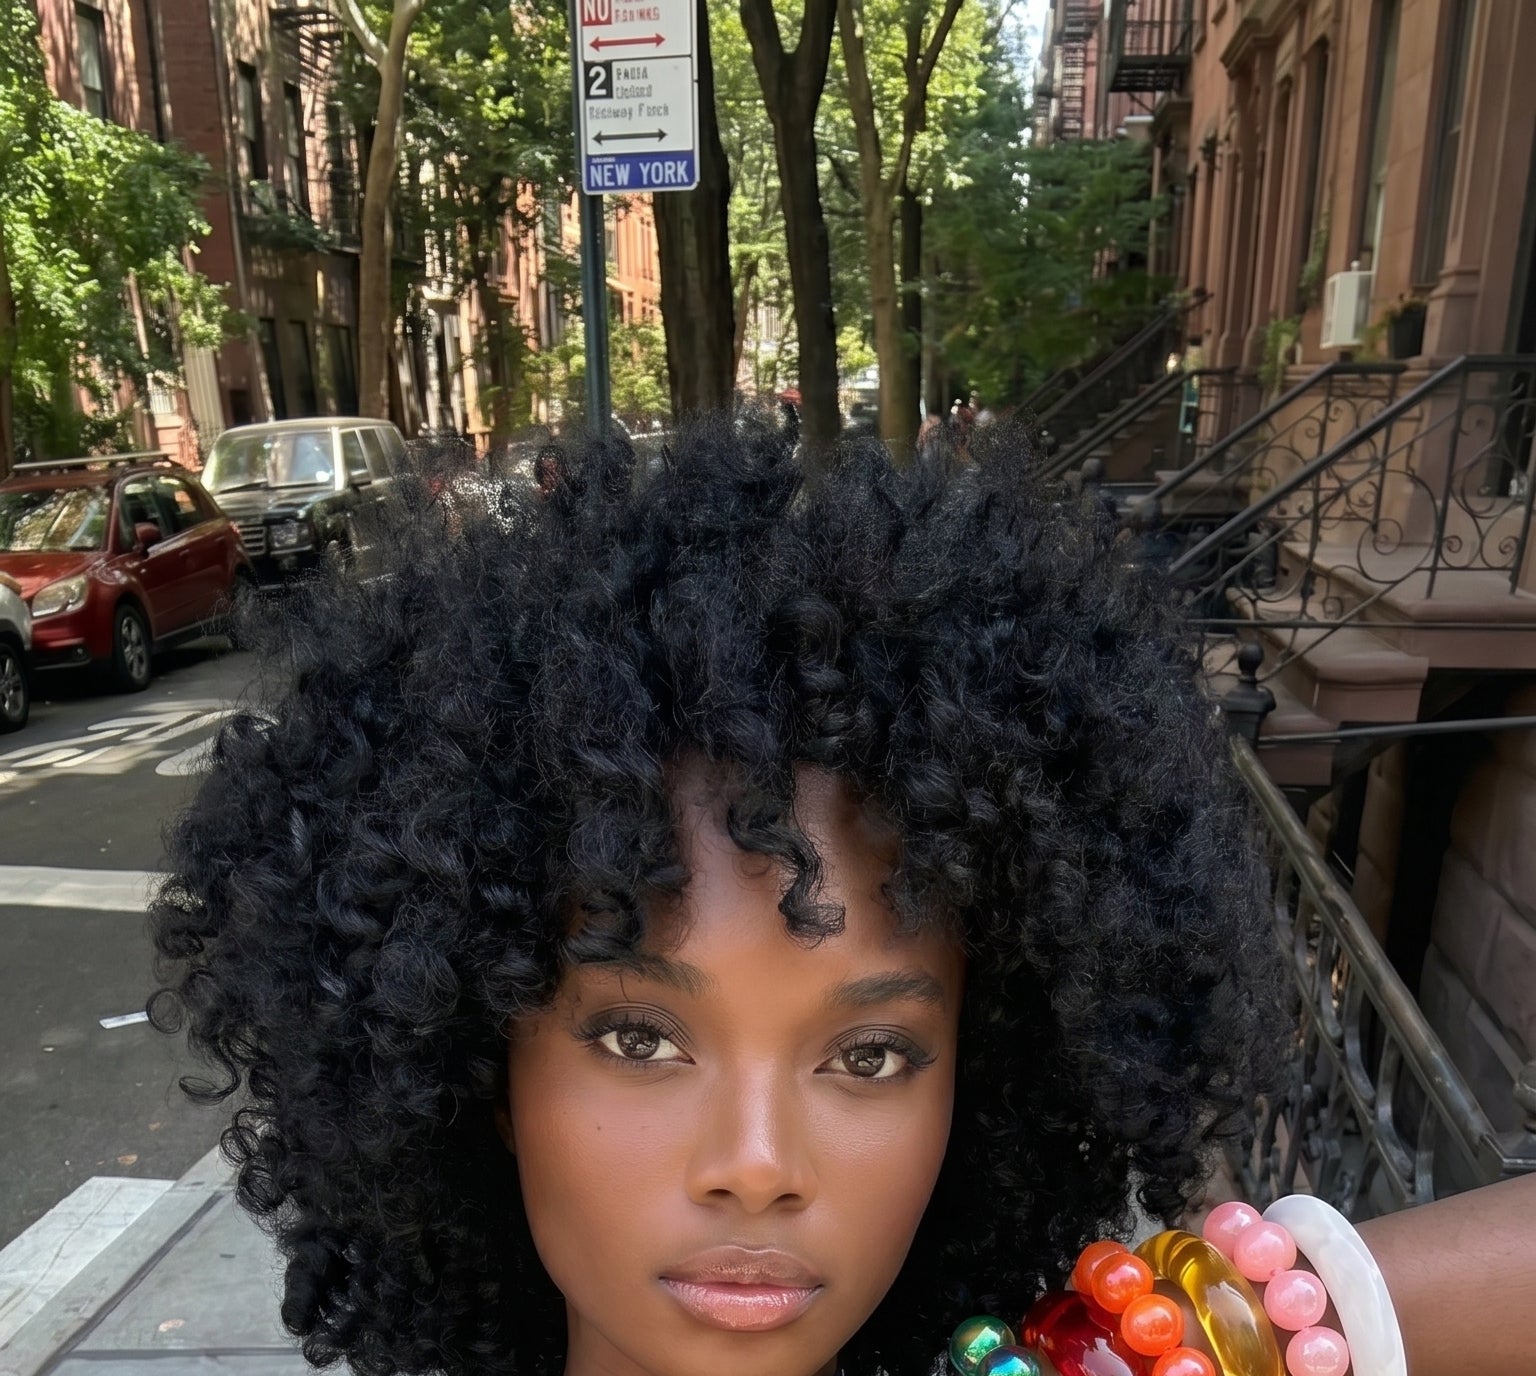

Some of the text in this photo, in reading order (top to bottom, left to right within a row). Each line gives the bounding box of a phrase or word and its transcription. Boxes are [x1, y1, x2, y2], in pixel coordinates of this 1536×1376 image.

[583, 0, 609, 22] NO
[588, 65, 607, 96] 2
[590, 160, 689, 187] NEW YORK
